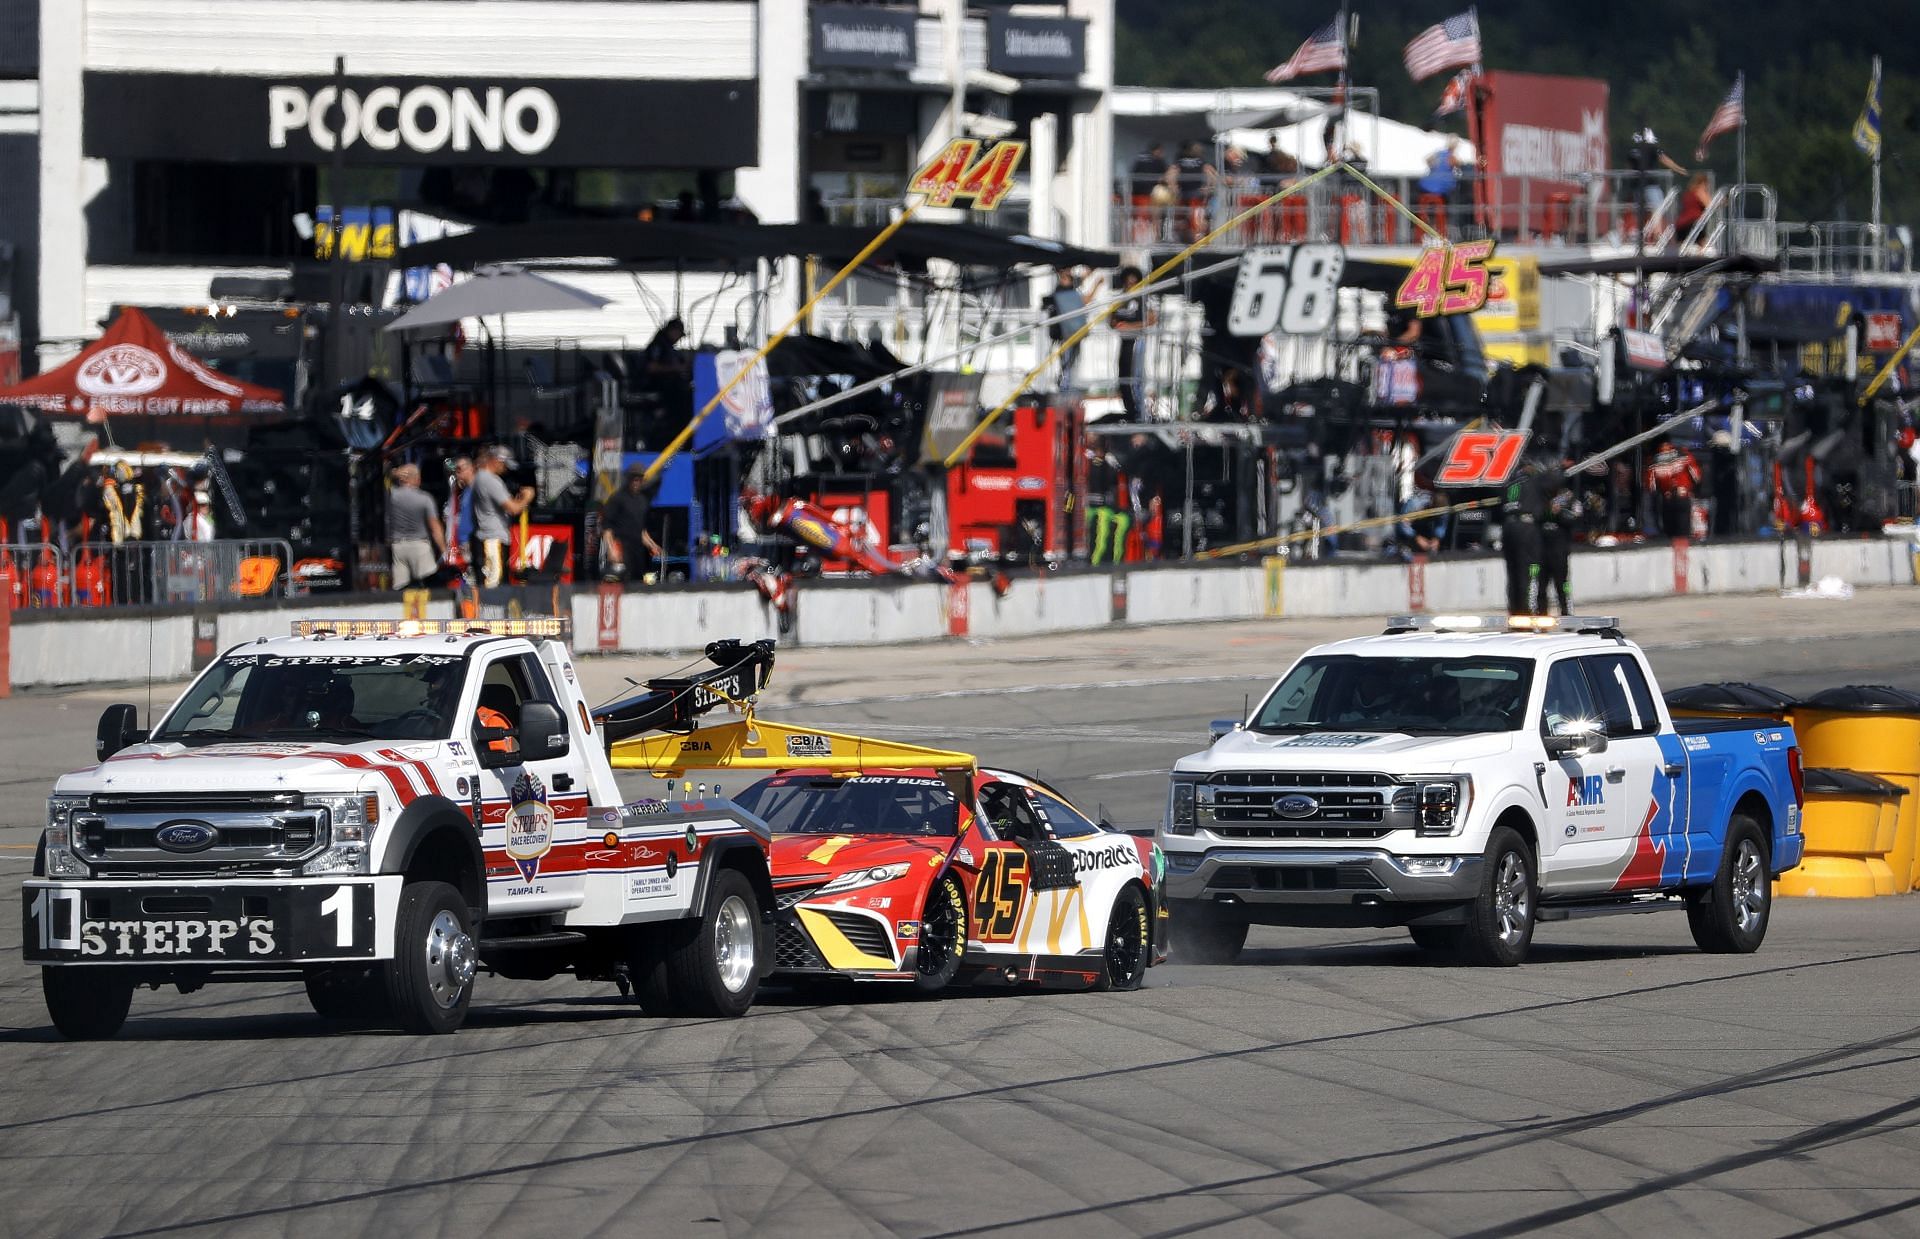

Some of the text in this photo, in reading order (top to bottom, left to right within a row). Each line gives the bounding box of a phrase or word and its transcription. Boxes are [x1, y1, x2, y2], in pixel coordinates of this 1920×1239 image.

[269, 85, 560, 154] POCONO
[907, 137, 1027, 211] 44
[1228, 243, 1346, 337] 68
[1395, 238, 1496, 317] 45
[1441, 434, 1526, 482] 51
[265, 655, 402, 667] STEPP'S
[848, 776, 946, 786] KURT BUSC
[1566, 775, 1604, 806] AMR
[511, 813, 549, 834] STEPP'S
[511, 834, 548, 847] RACE RECOVERY
[1072, 844, 1140, 873] cDonald's
[507, 886, 533, 896] TAMPA
[974, 848, 1028, 940] 45
[81, 916, 276, 955] STEPP'S
[321, 885, 353, 947] 1
